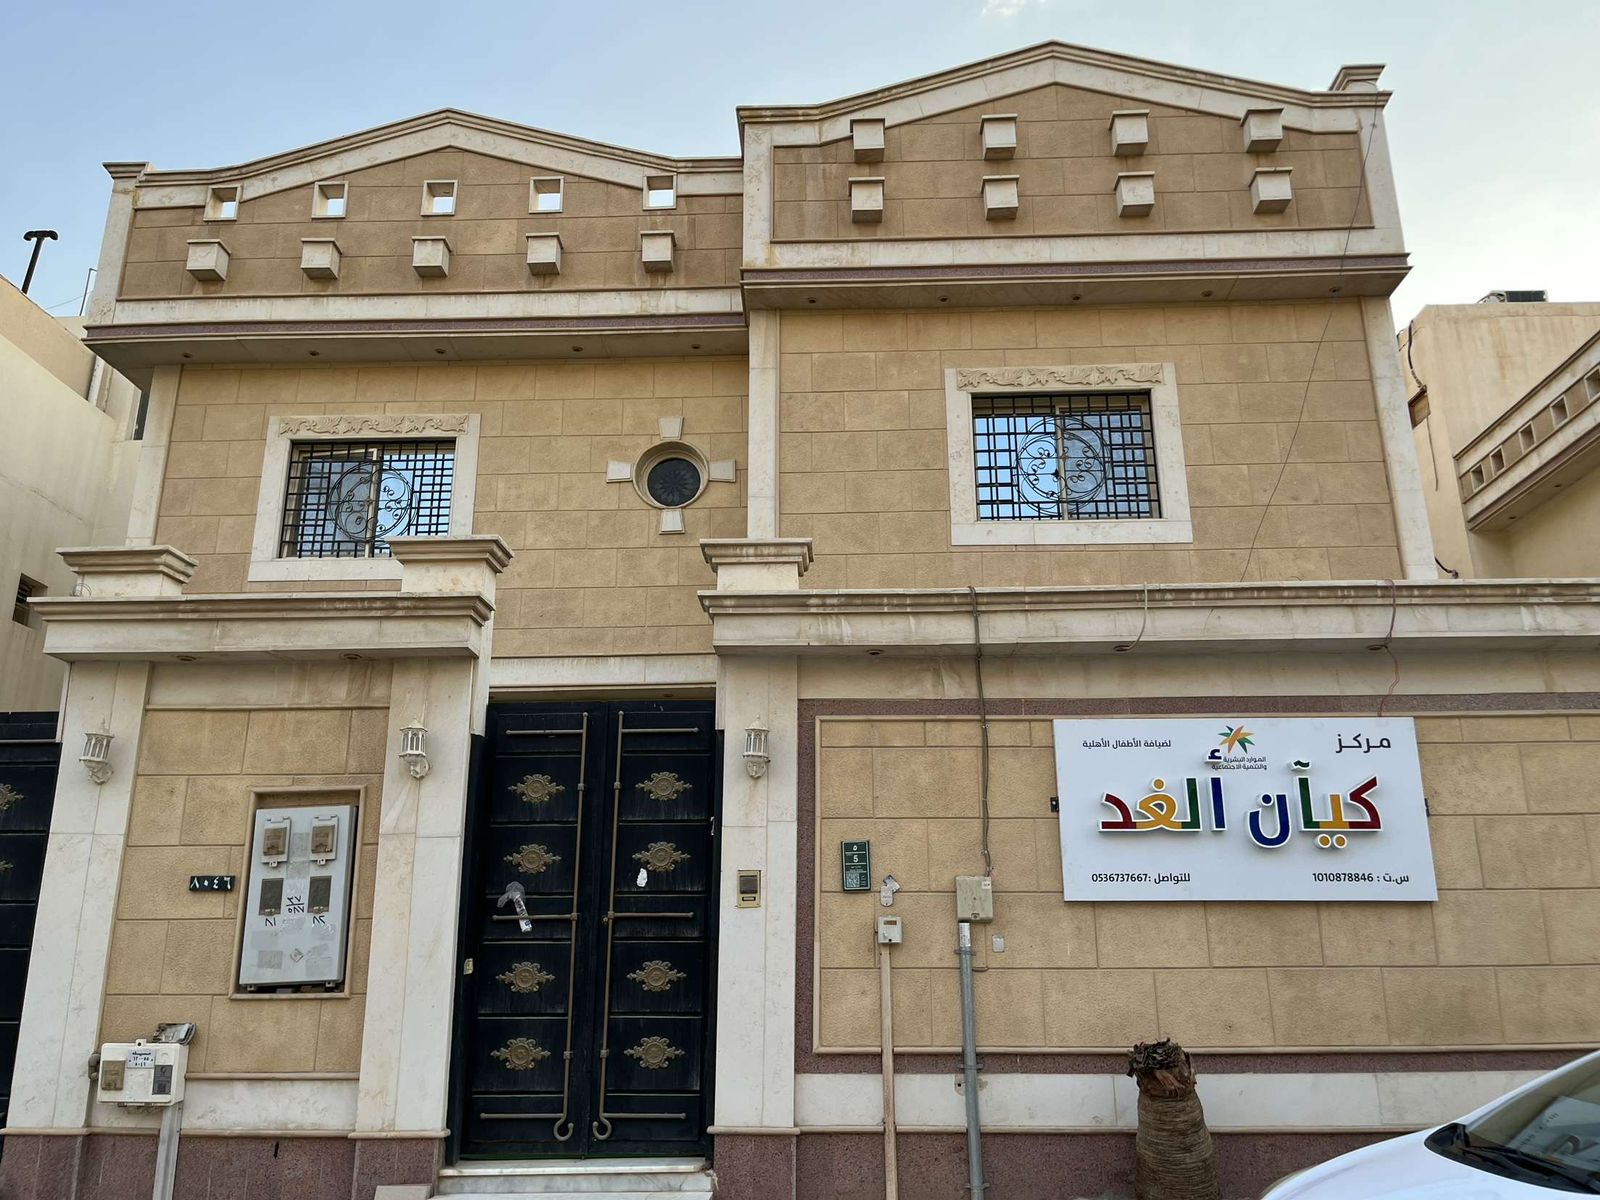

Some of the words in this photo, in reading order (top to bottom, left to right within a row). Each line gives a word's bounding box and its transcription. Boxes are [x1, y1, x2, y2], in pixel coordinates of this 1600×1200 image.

[1082, 739, 1110, 749] الأهلية
[1112, 738, 1142, 750] الأطفال
[1143, 739, 1172, 748] لضيافة
[1335, 733, 1392, 754] مركز
[853, 854, 859, 863] 5
[1153, 873, 1191, 885] للتواصل
[1312, 872, 1374, 882] 1010878846
[190, 876, 232, 890] ٨٠٤٦
